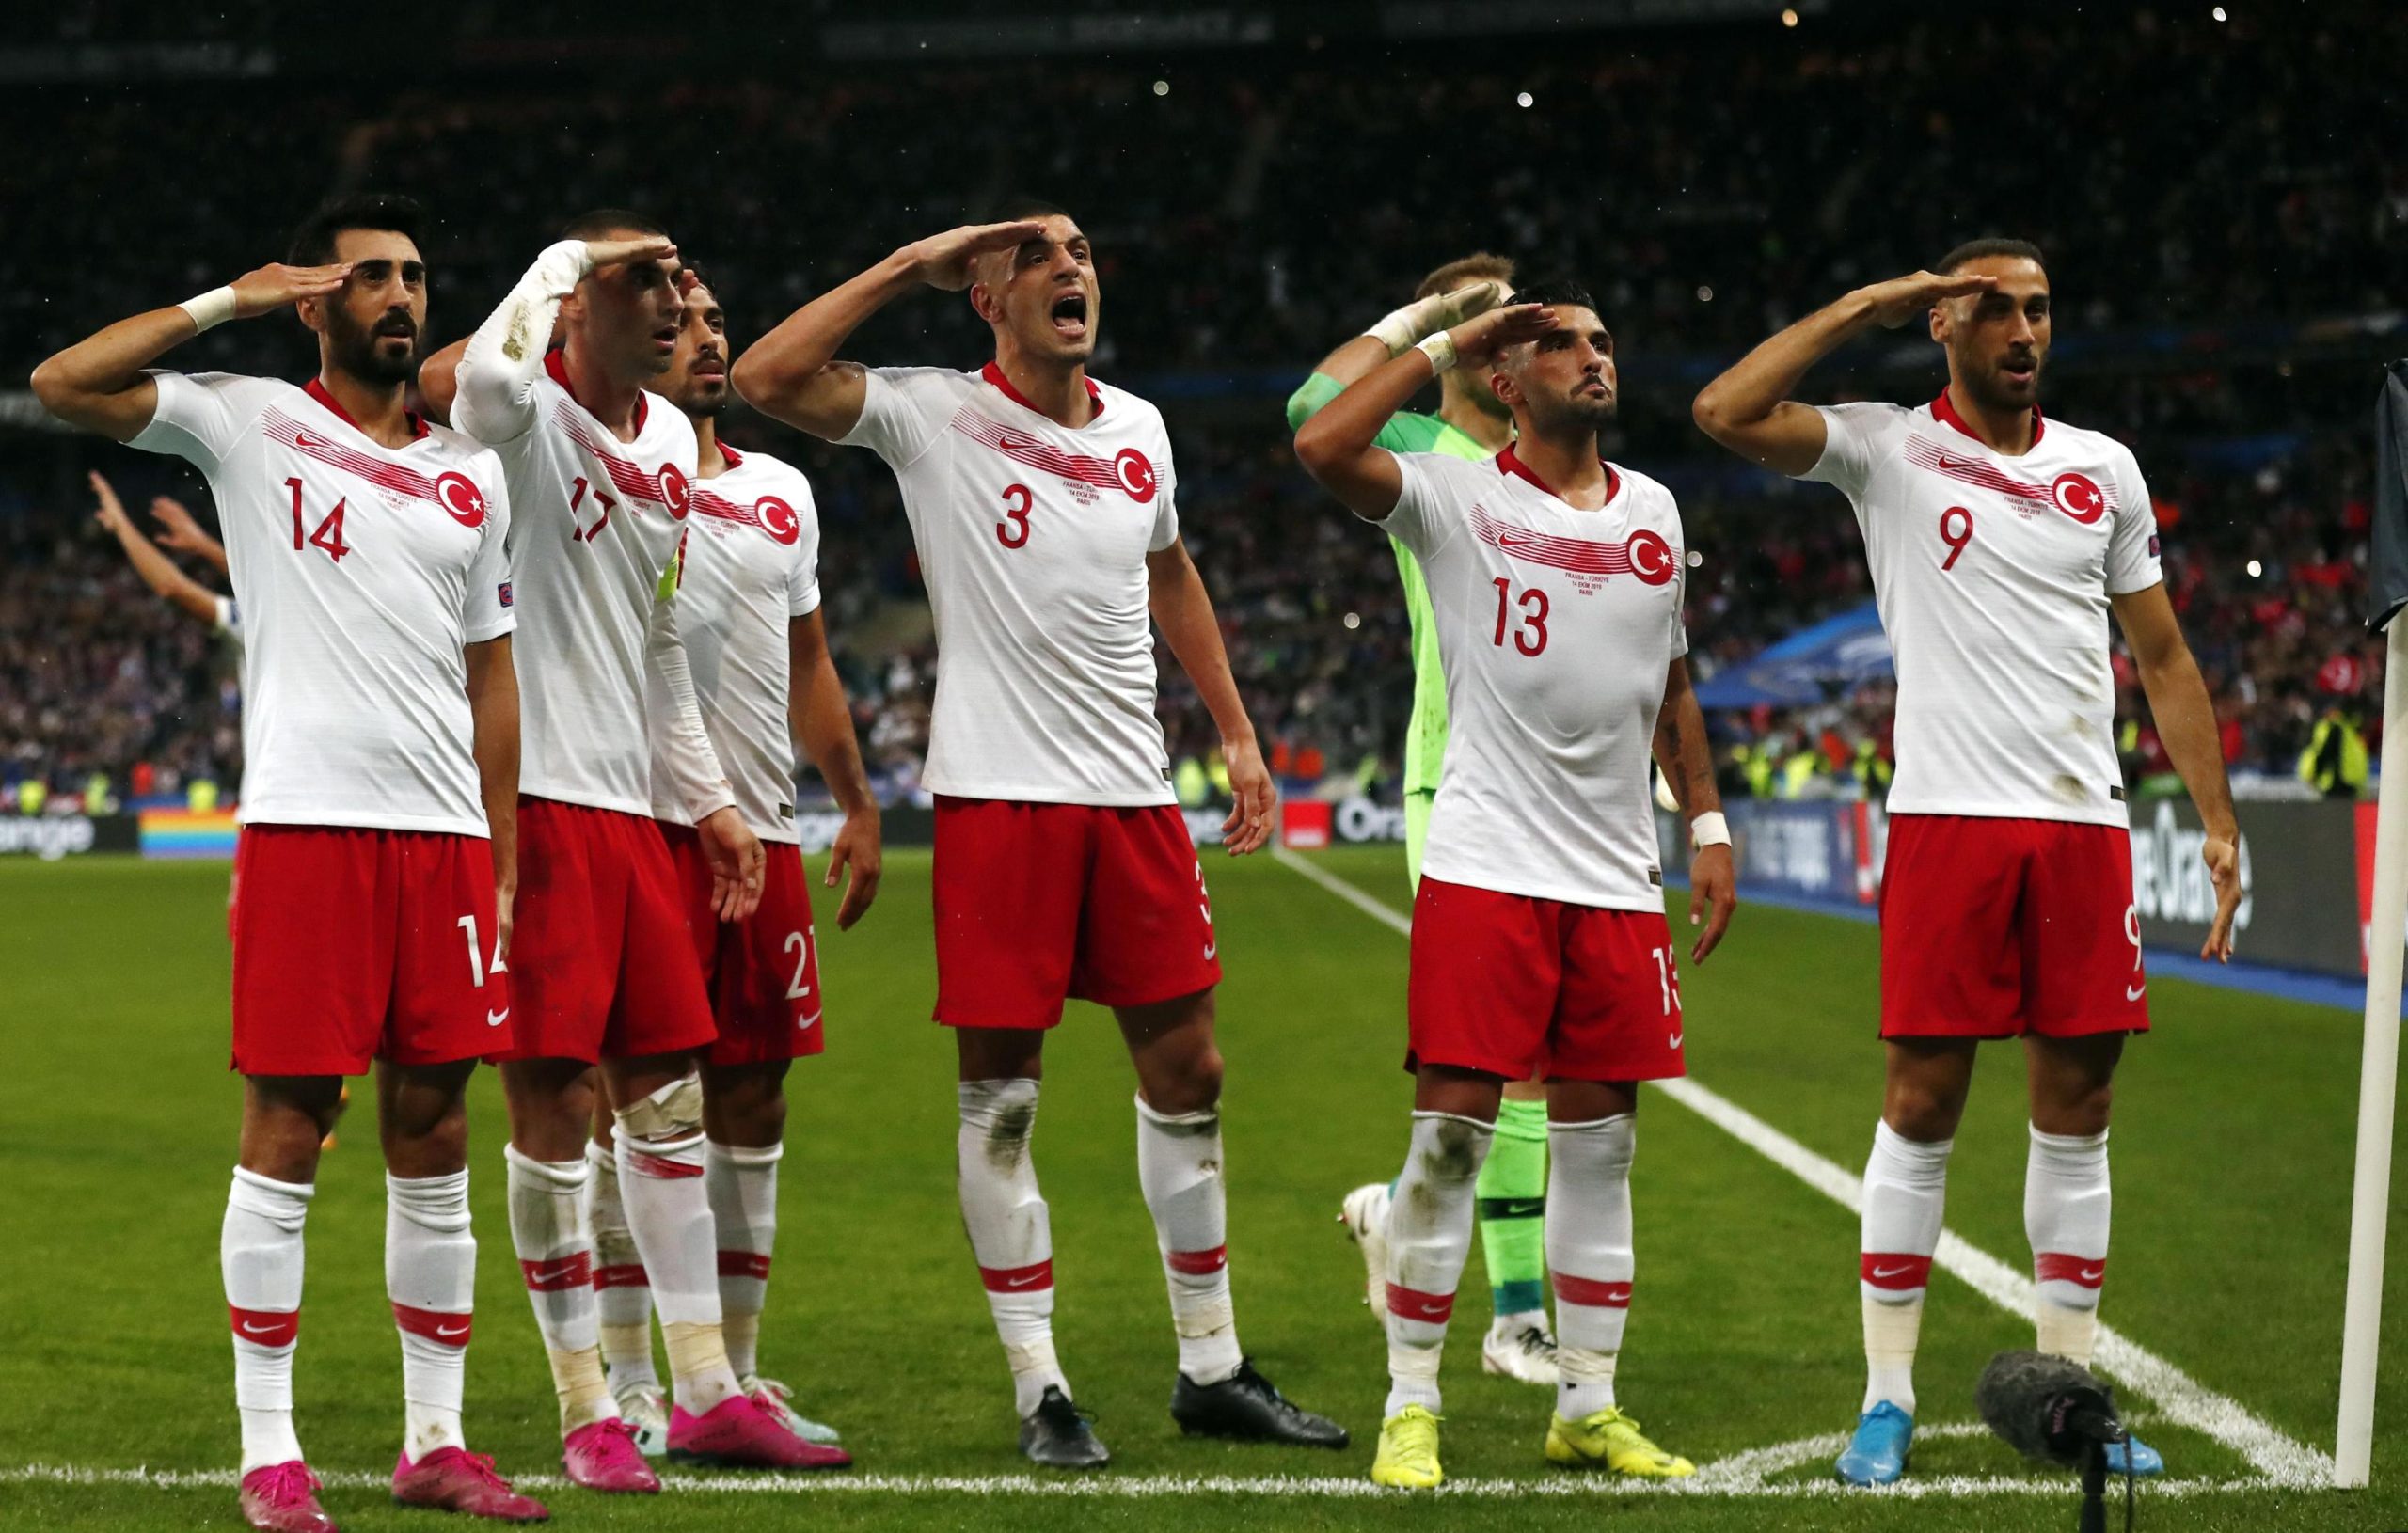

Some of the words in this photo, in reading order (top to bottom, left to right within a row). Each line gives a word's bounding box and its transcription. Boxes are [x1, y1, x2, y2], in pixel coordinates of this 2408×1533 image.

[284, 476, 351, 562] 14
[569, 476, 618, 544] 17
[996, 483, 1033, 549] 3
[1940, 506, 1974, 572] 9
[1492, 576, 1550, 657] 13
[2124, 904, 2142, 972] 9
